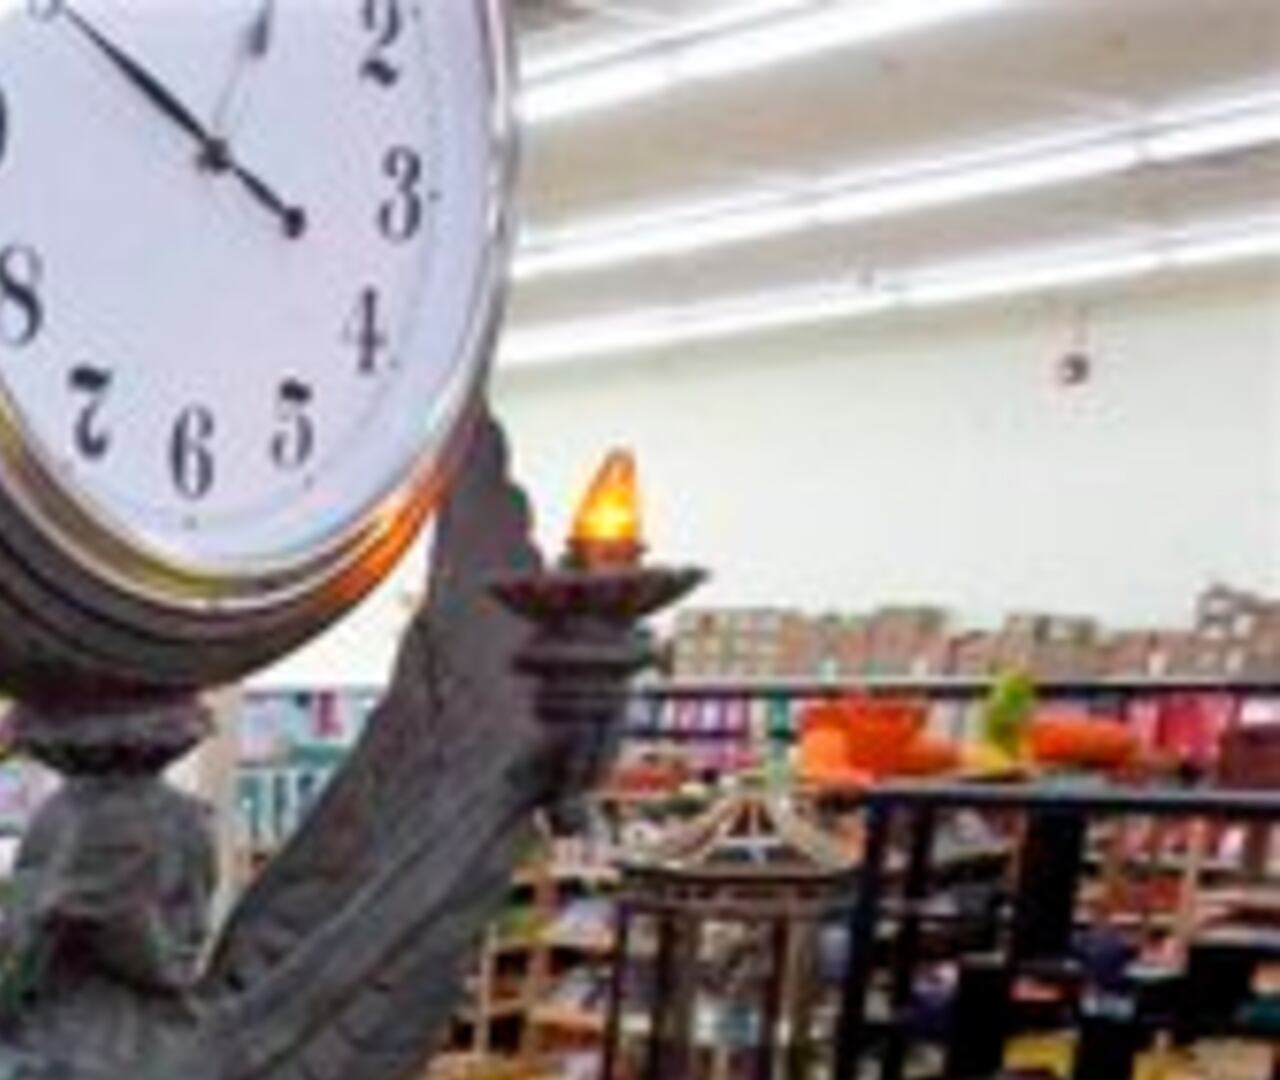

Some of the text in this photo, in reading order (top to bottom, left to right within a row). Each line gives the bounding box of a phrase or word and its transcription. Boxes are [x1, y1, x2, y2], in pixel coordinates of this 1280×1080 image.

[359, 0, 403, 87] 2
[378, 147, 423, 240] 3
[343, 286, 387, 375] 4
[68, 364, 112, 460] 7
[169, 408, 215, 499] 6
[271, 379, 313, 466] 5
